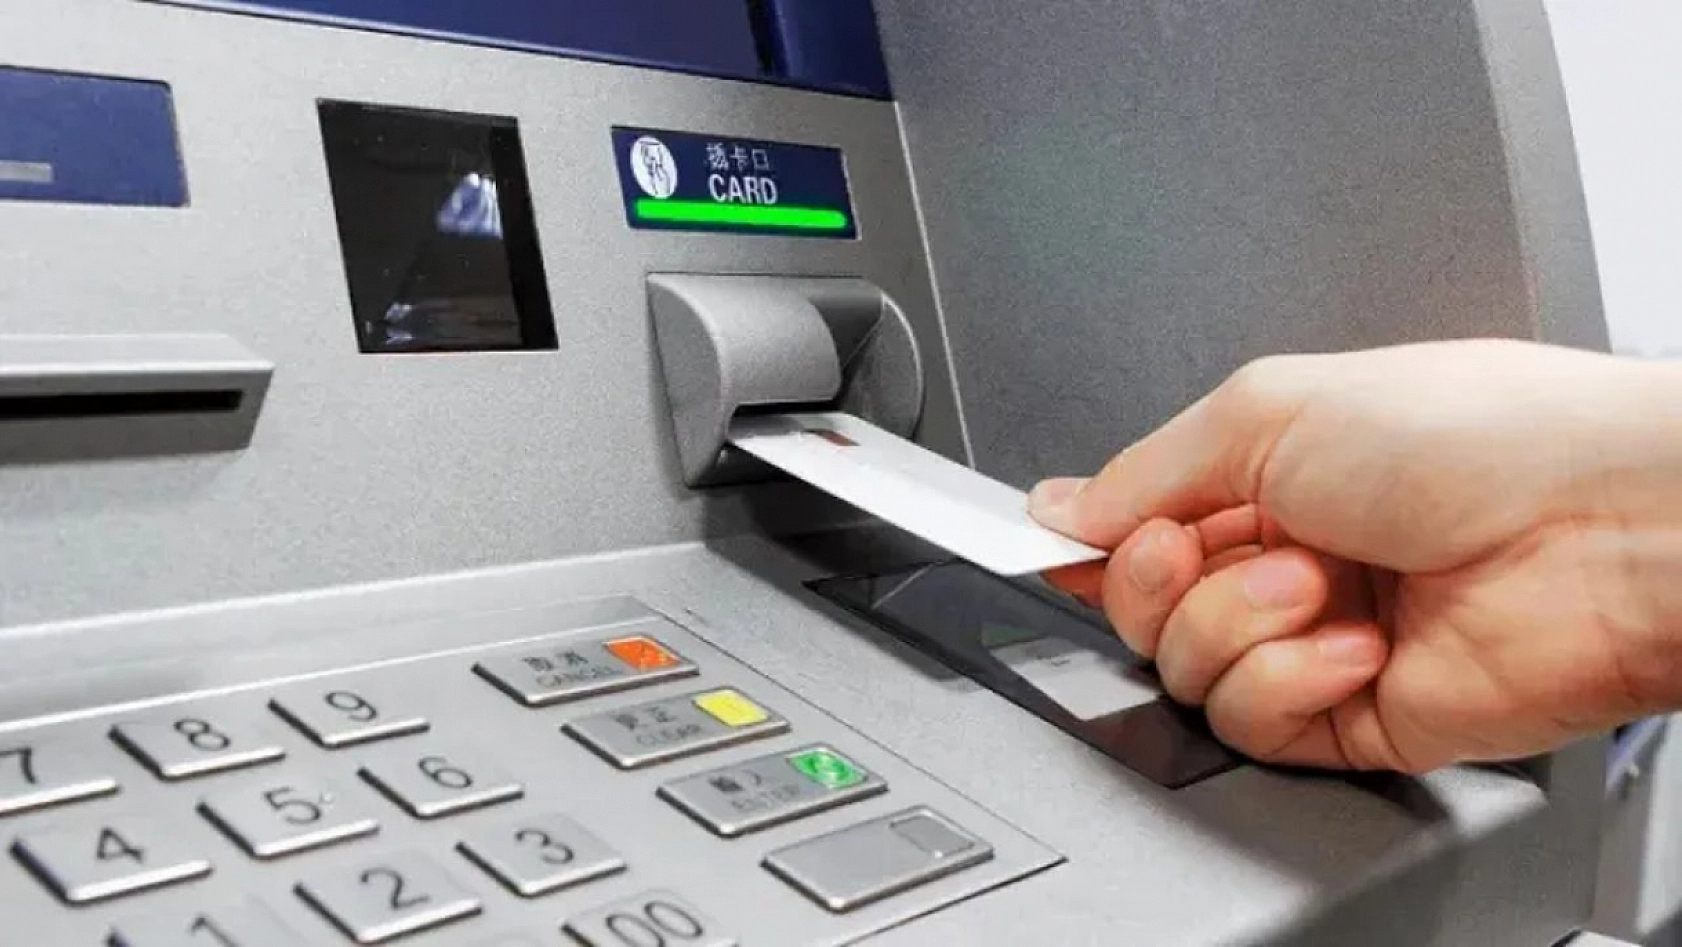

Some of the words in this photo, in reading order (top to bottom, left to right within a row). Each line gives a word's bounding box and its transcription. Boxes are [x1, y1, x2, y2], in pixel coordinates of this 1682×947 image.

[708, 173, 778, 205] CARD
[324, 689, 378, 722] 9
[173, 718, 231, 750] 8
[0, 746, 37, 784] 7
[418, 755, 473, 789] 6
[264, 787, 321, 825] 5
[97, 827, 143, 862] 4
[514, 826, 574, 865] 3
[360, 867, 432, 911] 2
[605, 901, 704, 947] 00
